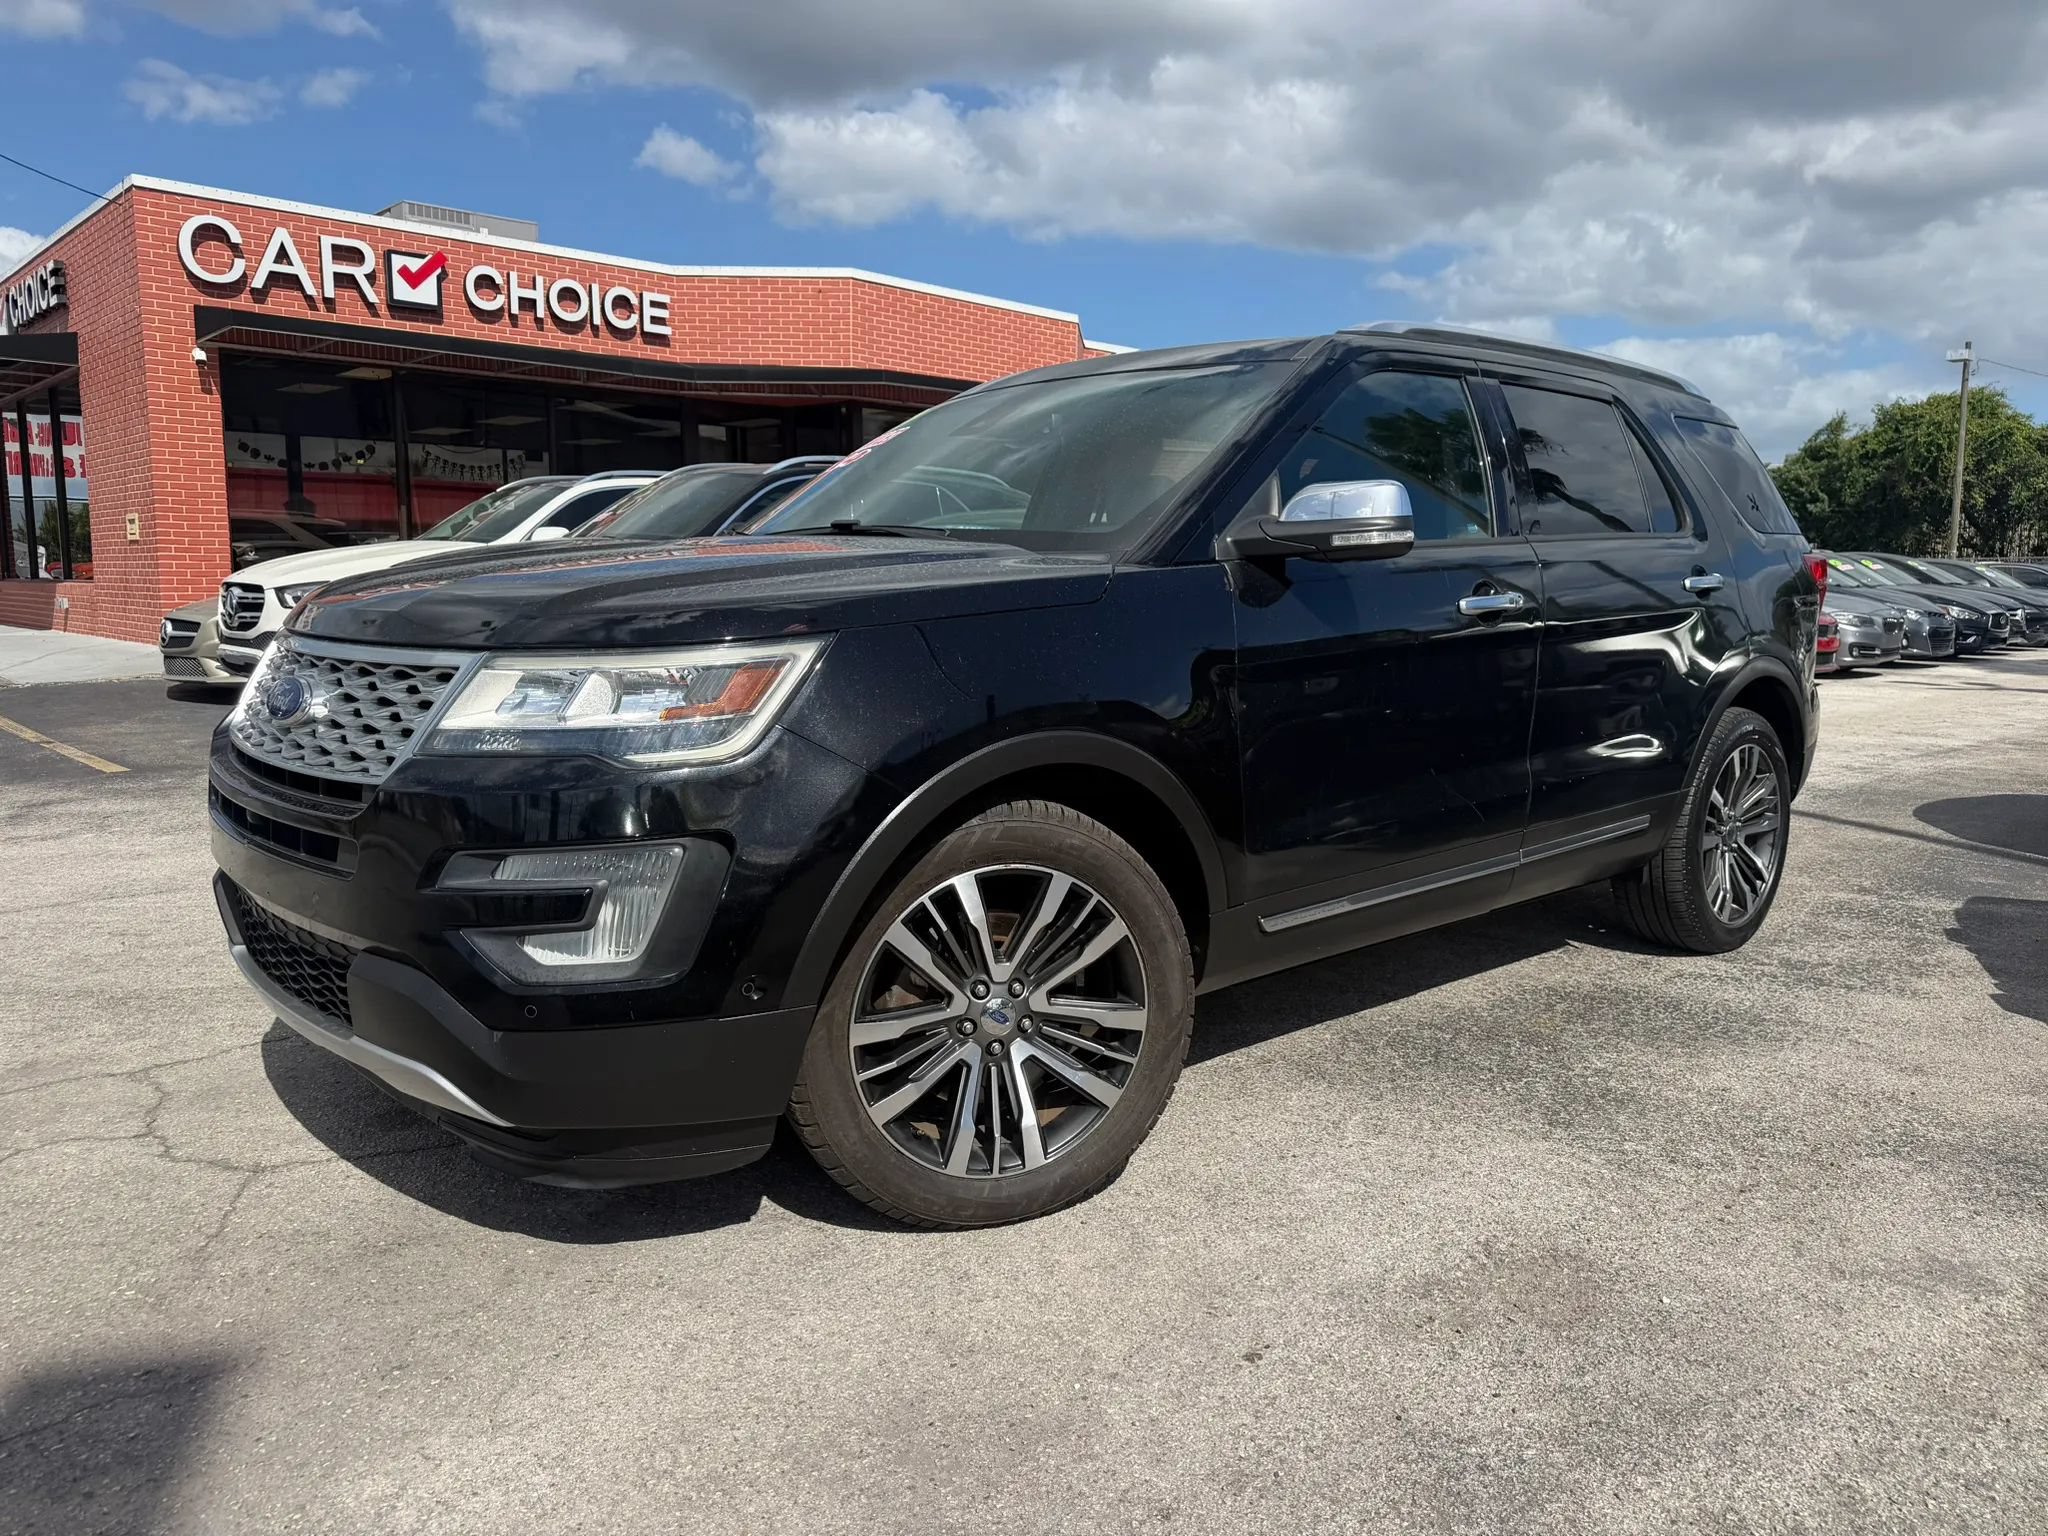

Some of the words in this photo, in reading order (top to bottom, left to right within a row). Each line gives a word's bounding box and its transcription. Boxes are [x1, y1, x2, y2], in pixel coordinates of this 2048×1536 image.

[9, 260, 58, 327] CHOICE
[178, 215, 380, 303] CAR
[465, 265, 672, 335] CHOICE
